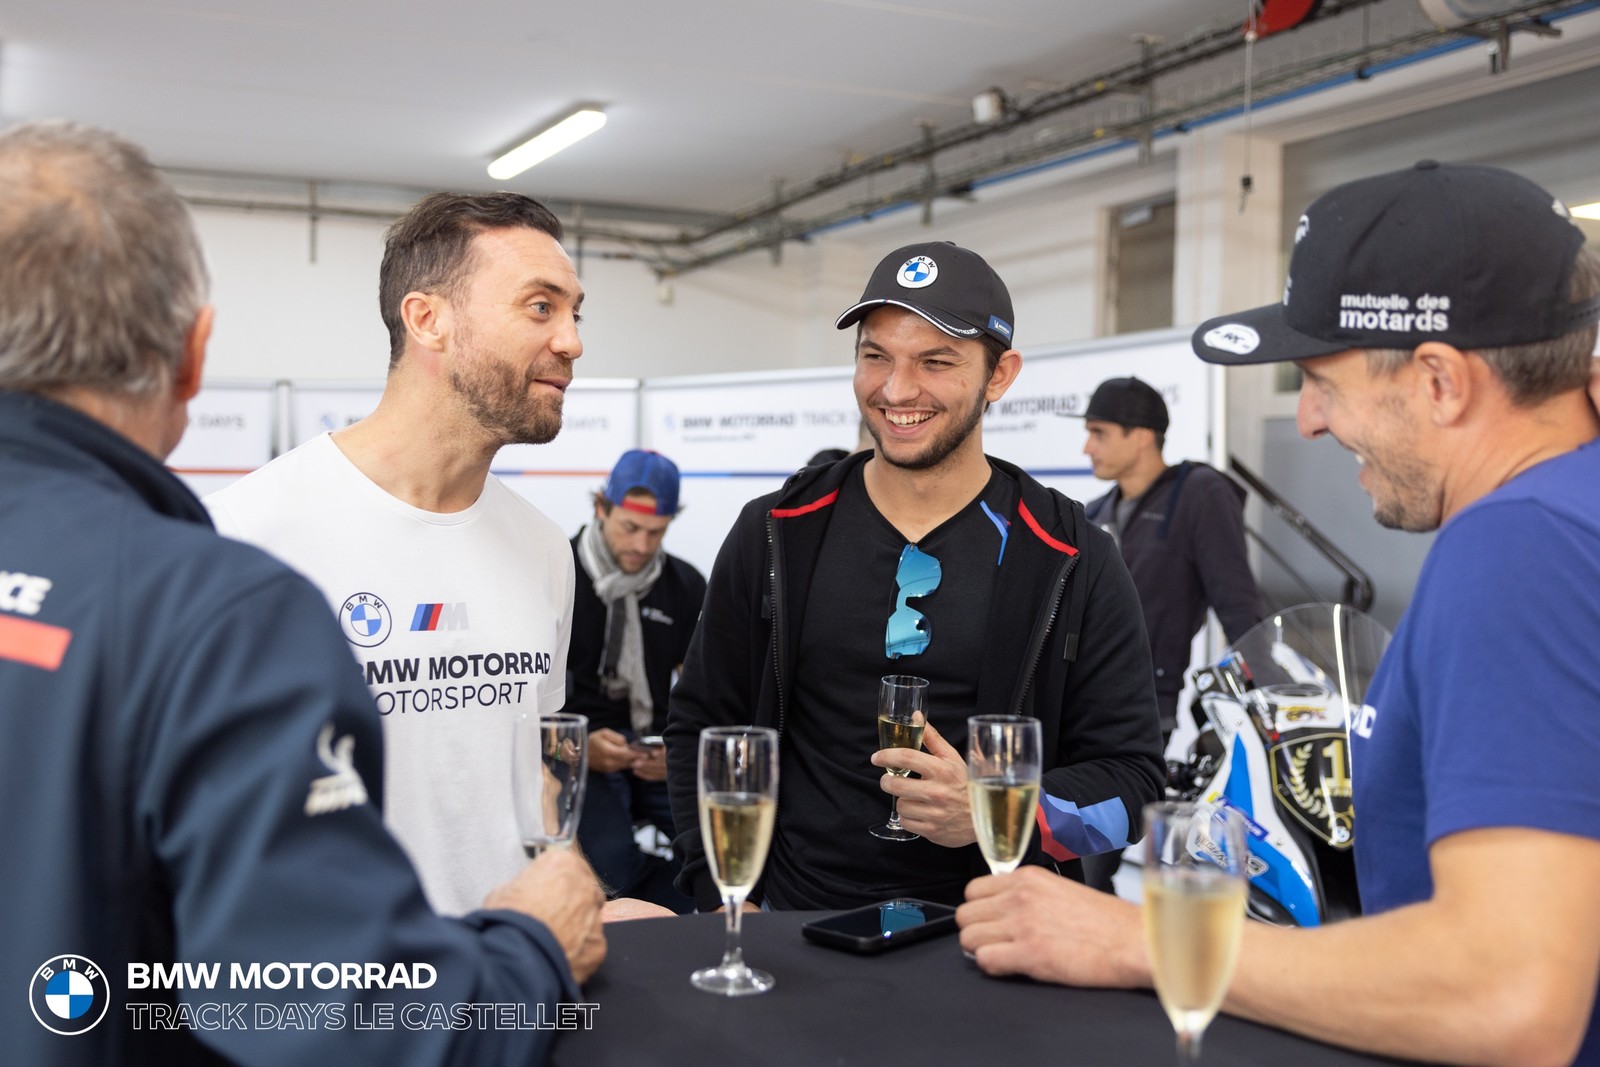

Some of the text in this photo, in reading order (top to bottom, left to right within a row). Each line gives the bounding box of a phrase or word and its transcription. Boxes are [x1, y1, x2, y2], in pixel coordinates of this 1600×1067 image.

[905, 256, 935, 269] BMW
[1340, 293, 1450, 310] mutuelle des
[1339, 308, 1449, 332] motards
[345, 595, 383, 612] BMW
[359, 651, 551, 686] MW MOTORRAD
[374, 681, 528, 716] OTORSPORT
[1322, 739, 1352, 787] 1
